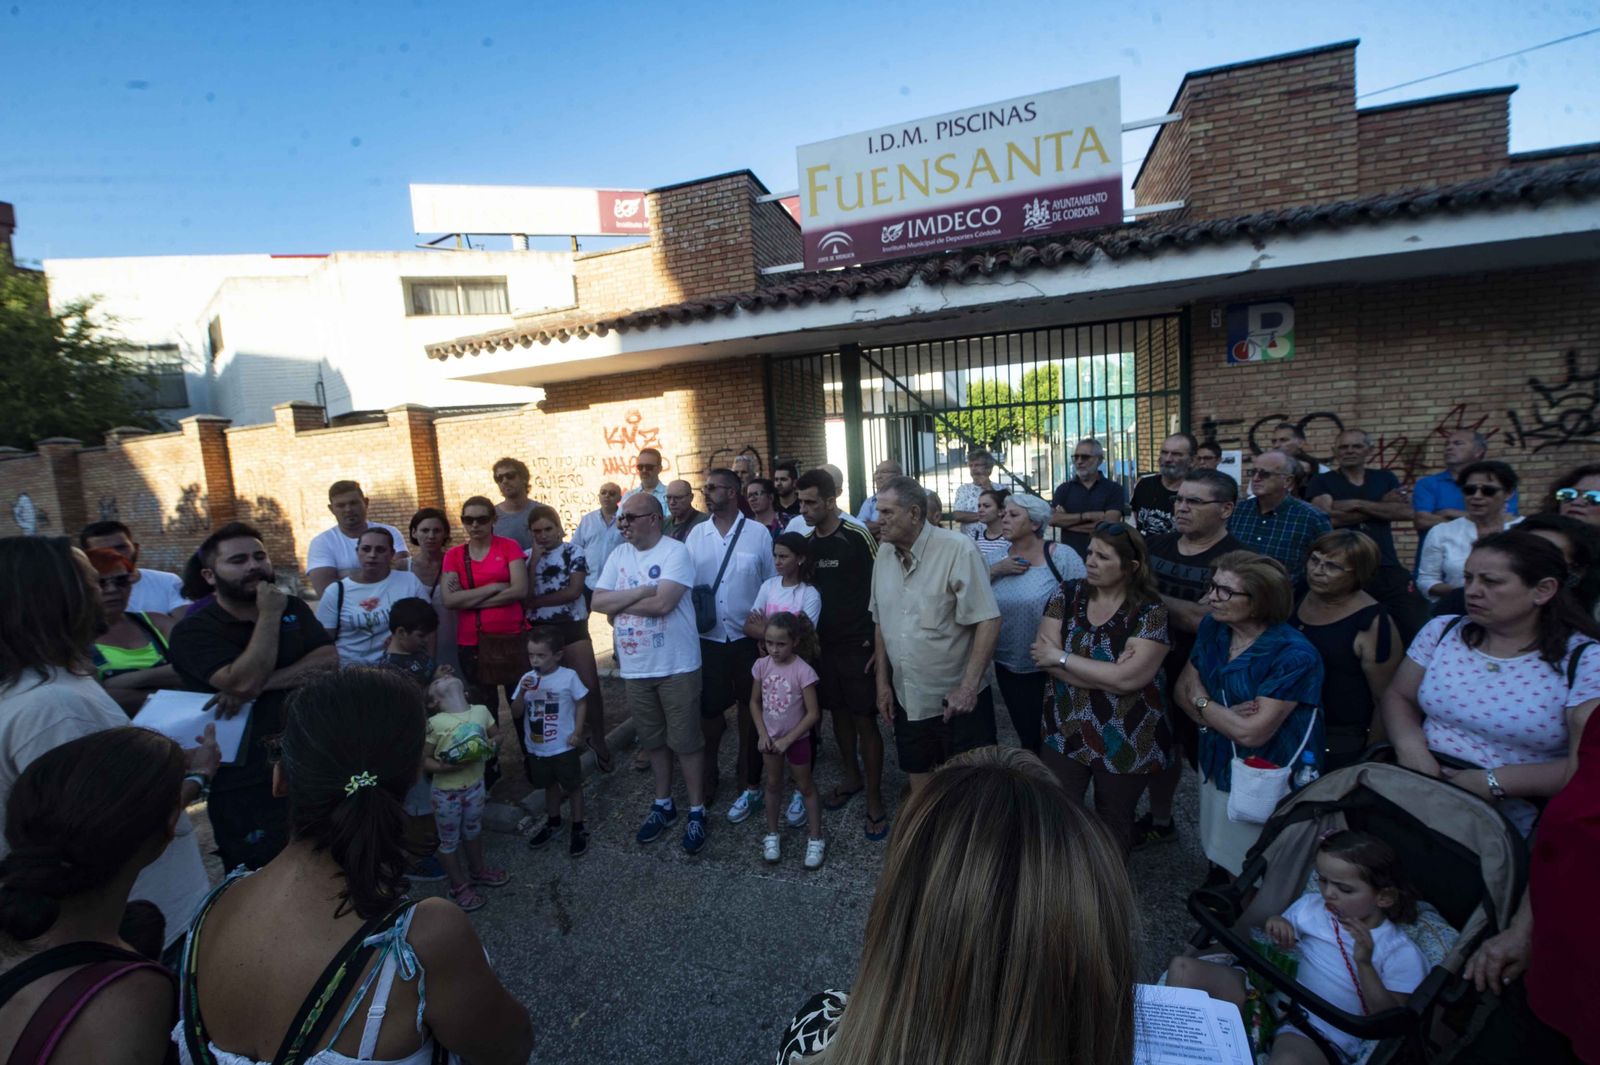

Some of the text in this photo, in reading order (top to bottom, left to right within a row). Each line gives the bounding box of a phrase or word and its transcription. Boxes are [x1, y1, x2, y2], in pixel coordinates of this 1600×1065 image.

[868, 101, 1037, 154] I.D.M. PISCINAS
[806, 126, 1111, 217] FUENSANTA
[1052, 191, 1108, 210] AYUNTAMIENTO
[908, 205, 1002, 239] IMDECO
[1052, 211, 1062, 222] DE
[907, 238, 936, 249] Municipal
[945, 233, 974, 243] Deportes
[544, 714, 559, 744] 1978
